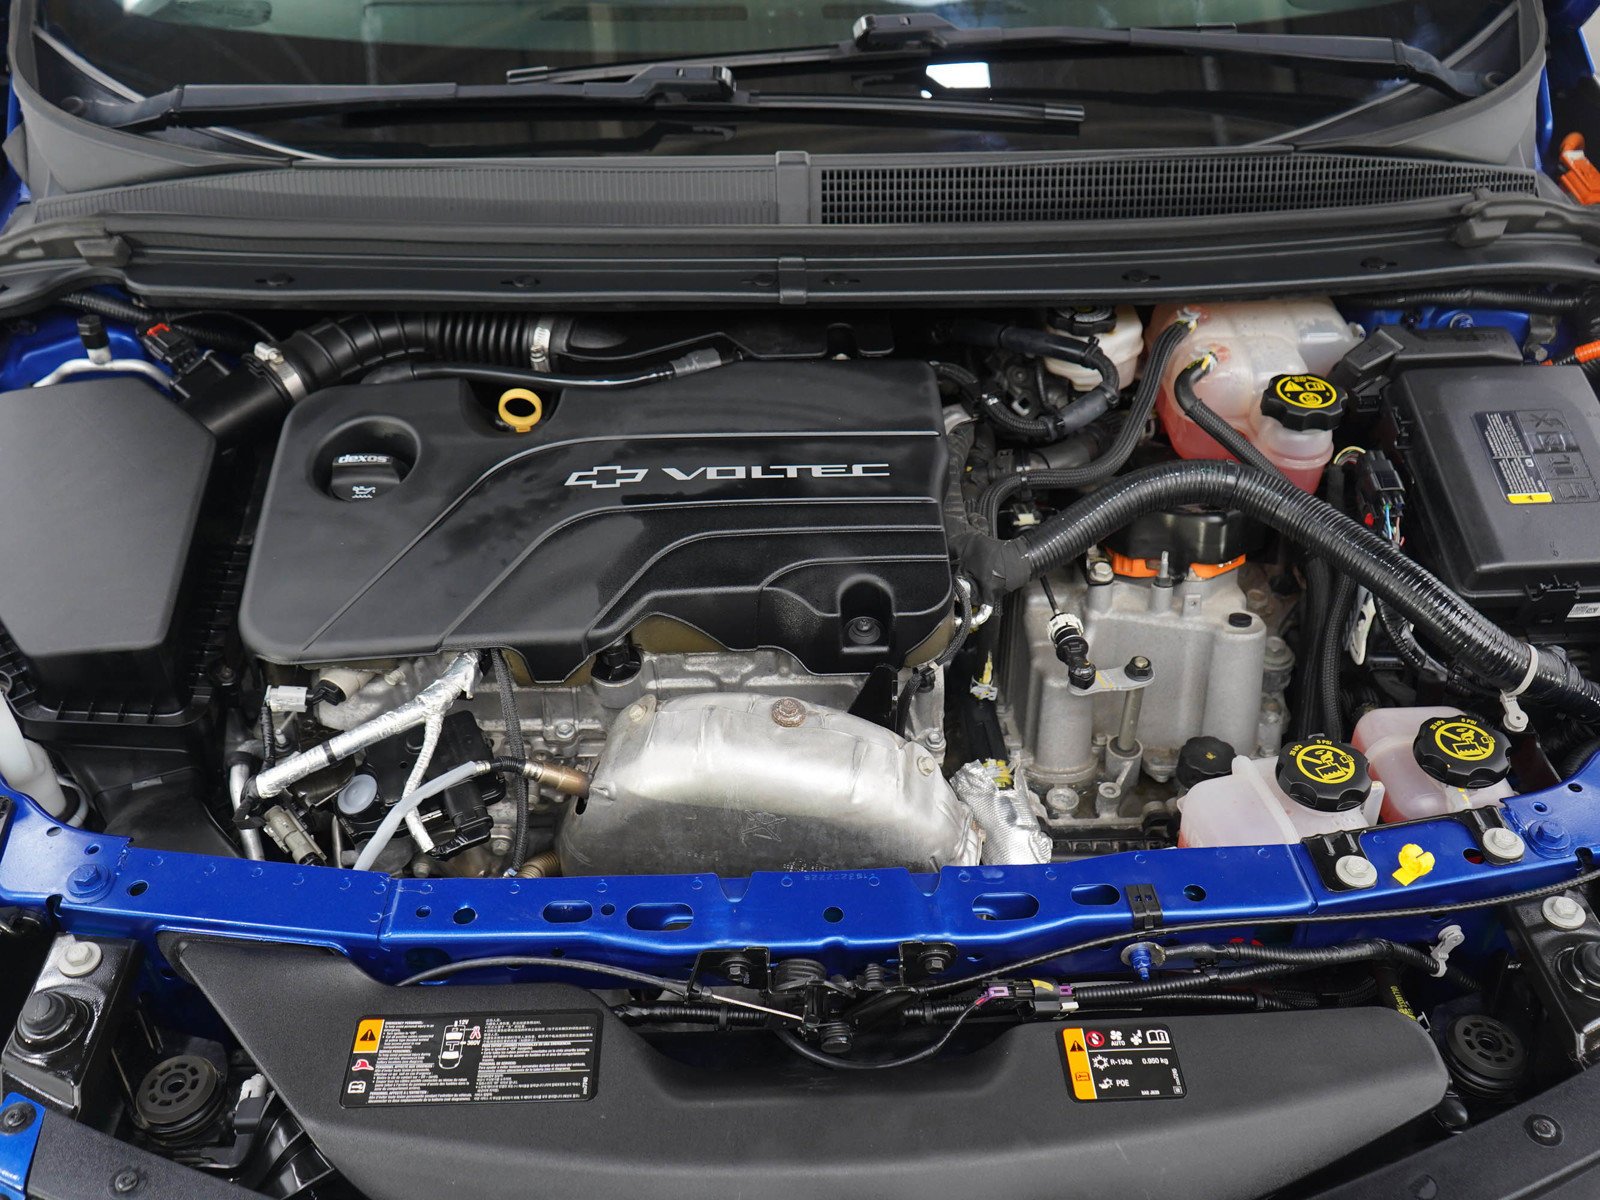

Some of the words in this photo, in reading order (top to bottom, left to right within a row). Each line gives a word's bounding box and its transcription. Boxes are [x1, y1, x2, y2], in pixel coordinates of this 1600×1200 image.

[338, 454, 390, 464] dexos
[661, 463, 890, 481] VOLTEC
[1160, 1057, 1169, 1065] kg
[1115, 1079, 1130, 1087] POE
